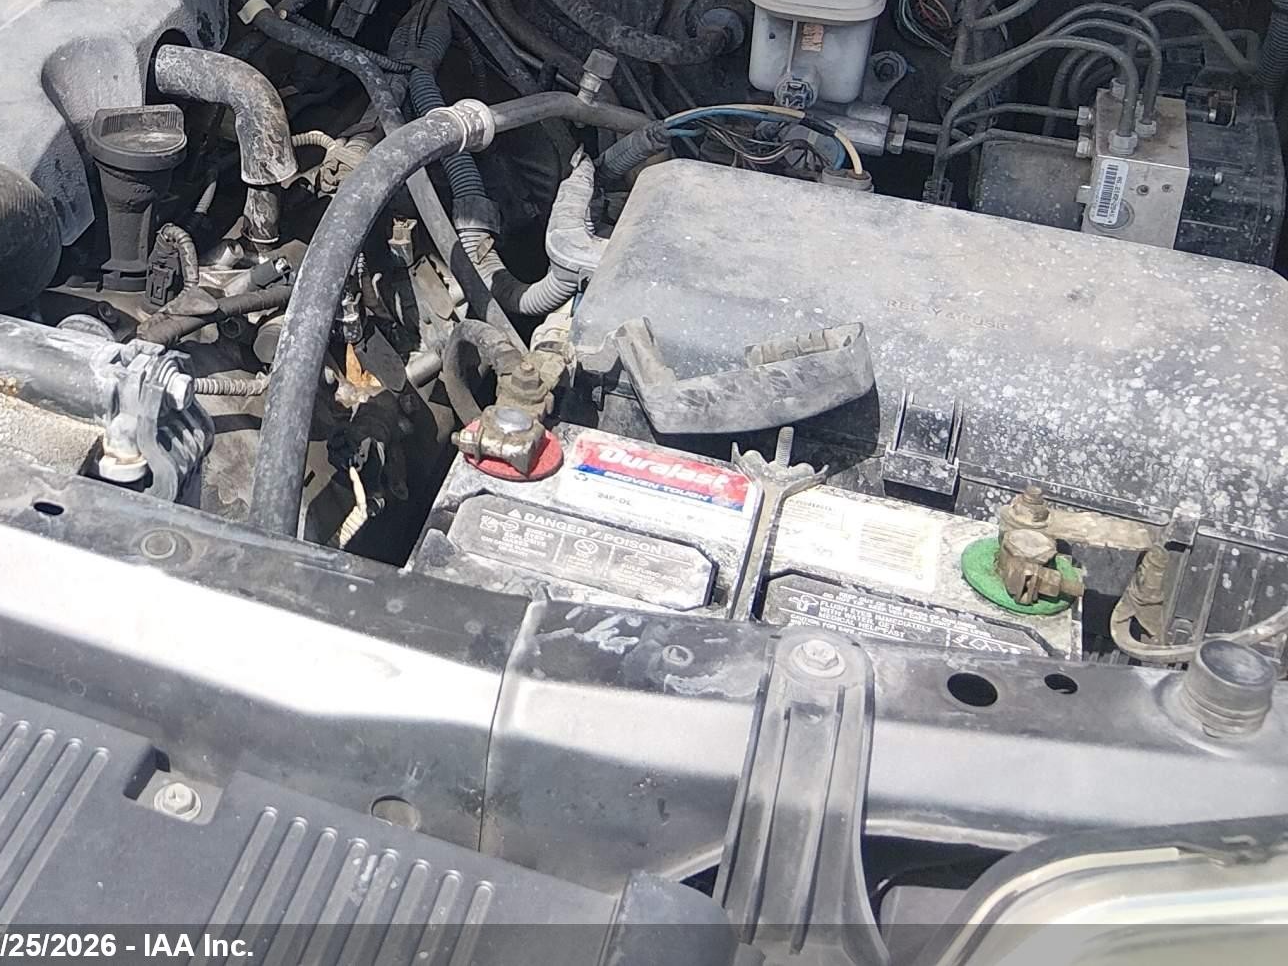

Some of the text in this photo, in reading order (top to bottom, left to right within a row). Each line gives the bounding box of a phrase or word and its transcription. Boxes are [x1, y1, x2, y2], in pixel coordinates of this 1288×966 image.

[598, 447, 730, 488] Duralast
[523, 512, 588, 535] DANGER
[603, 534, 662, 555] POISON
